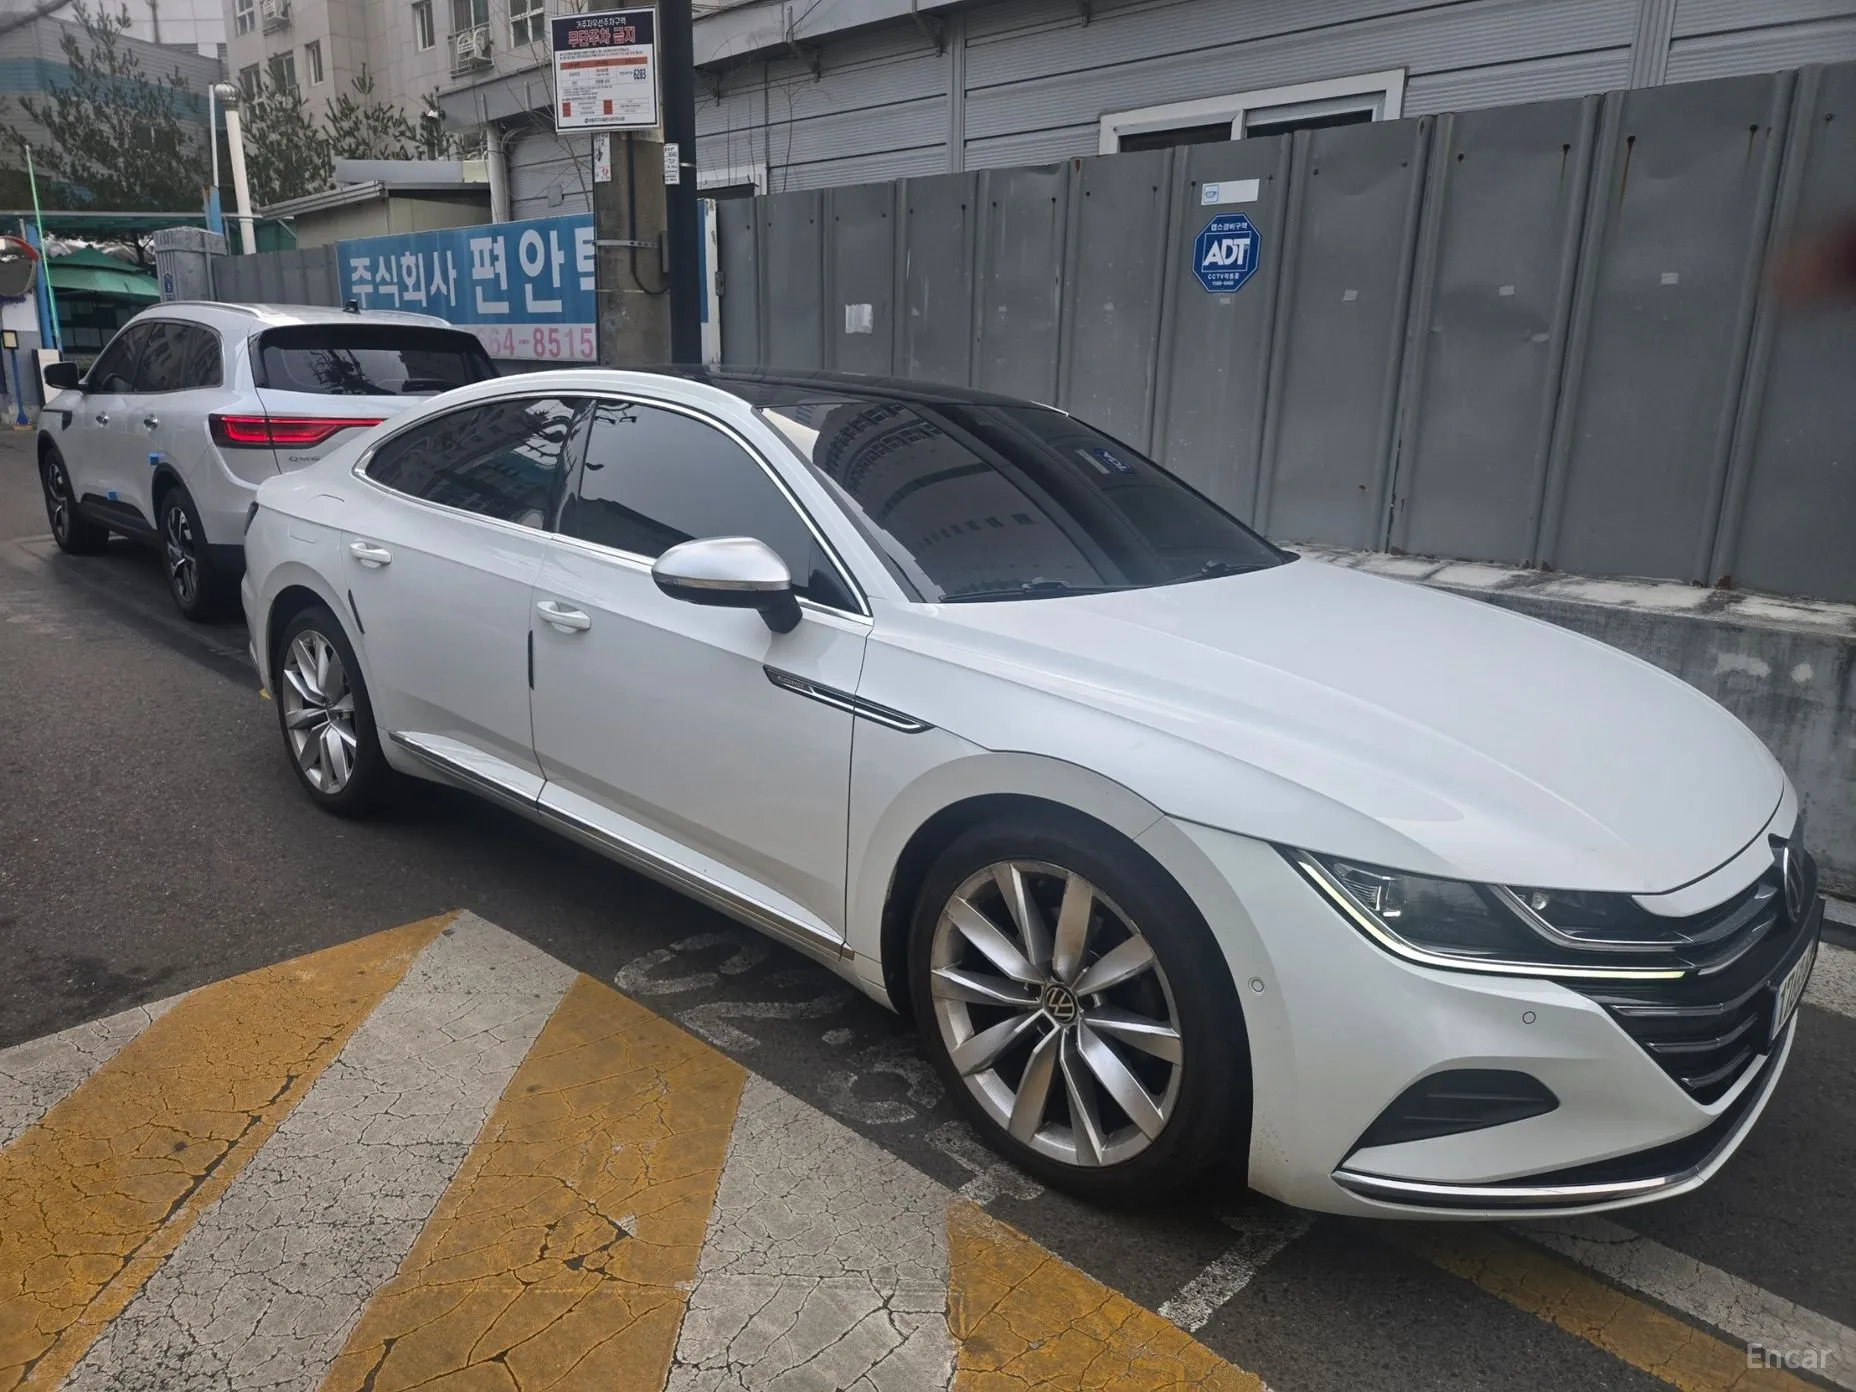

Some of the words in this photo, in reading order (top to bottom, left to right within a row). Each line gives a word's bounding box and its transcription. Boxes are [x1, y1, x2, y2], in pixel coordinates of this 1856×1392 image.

[568, 28, 610, 47] 무단주차
[613, 25, 636, 44] 금지
[1203, 238, 1251, 266] ADT
[350, 249, 456, 309] 주식회사
